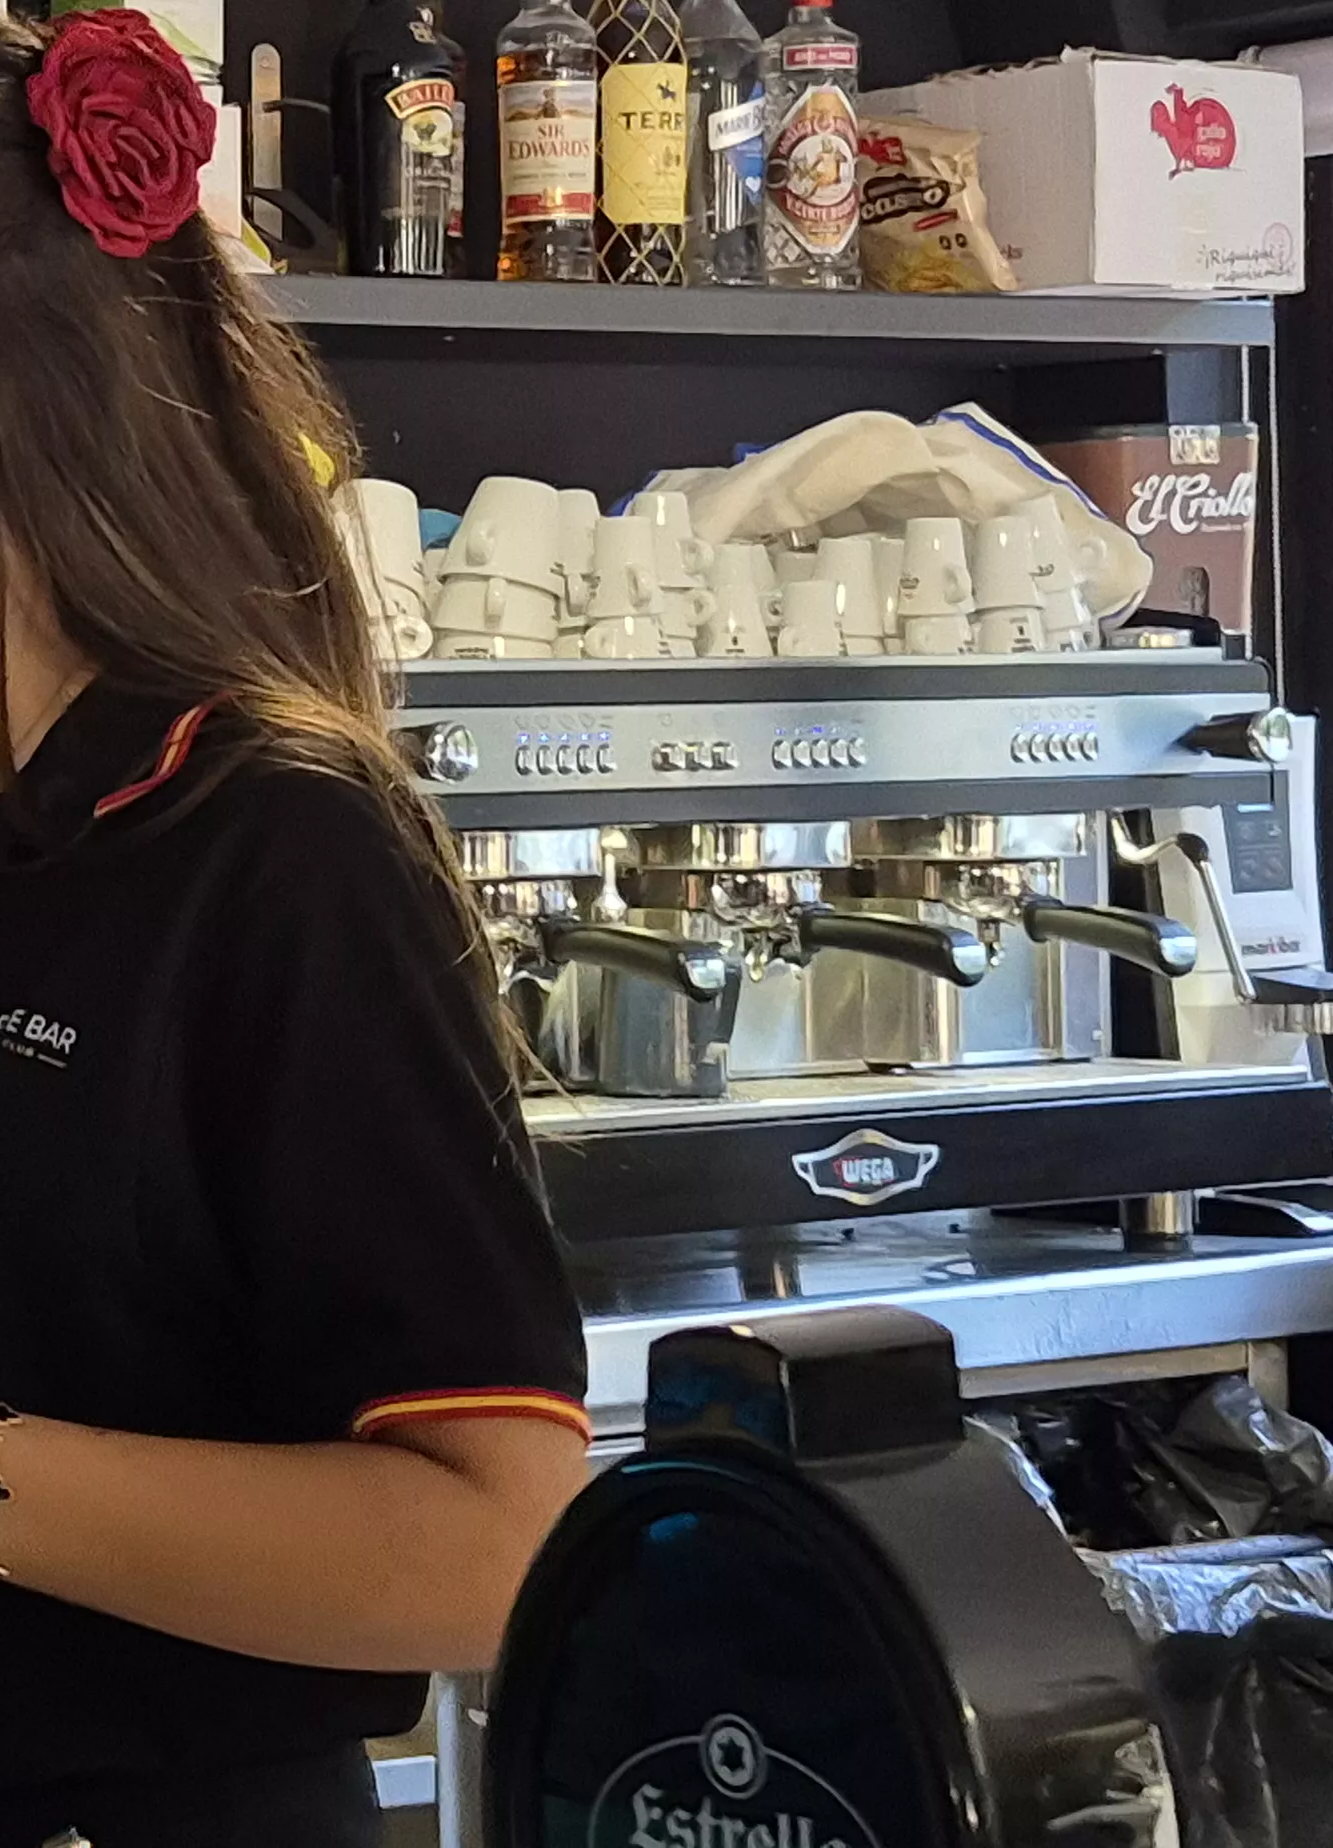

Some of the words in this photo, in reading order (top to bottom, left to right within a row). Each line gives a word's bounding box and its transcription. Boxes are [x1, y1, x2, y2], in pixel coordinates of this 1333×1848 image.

[537, 124, 565, 138] SIR
[23, 1013, 77, 1055] BAR
[842, 1156, 895, 1185] WEGA
[629, 1781, 856, 1848] Estrell
